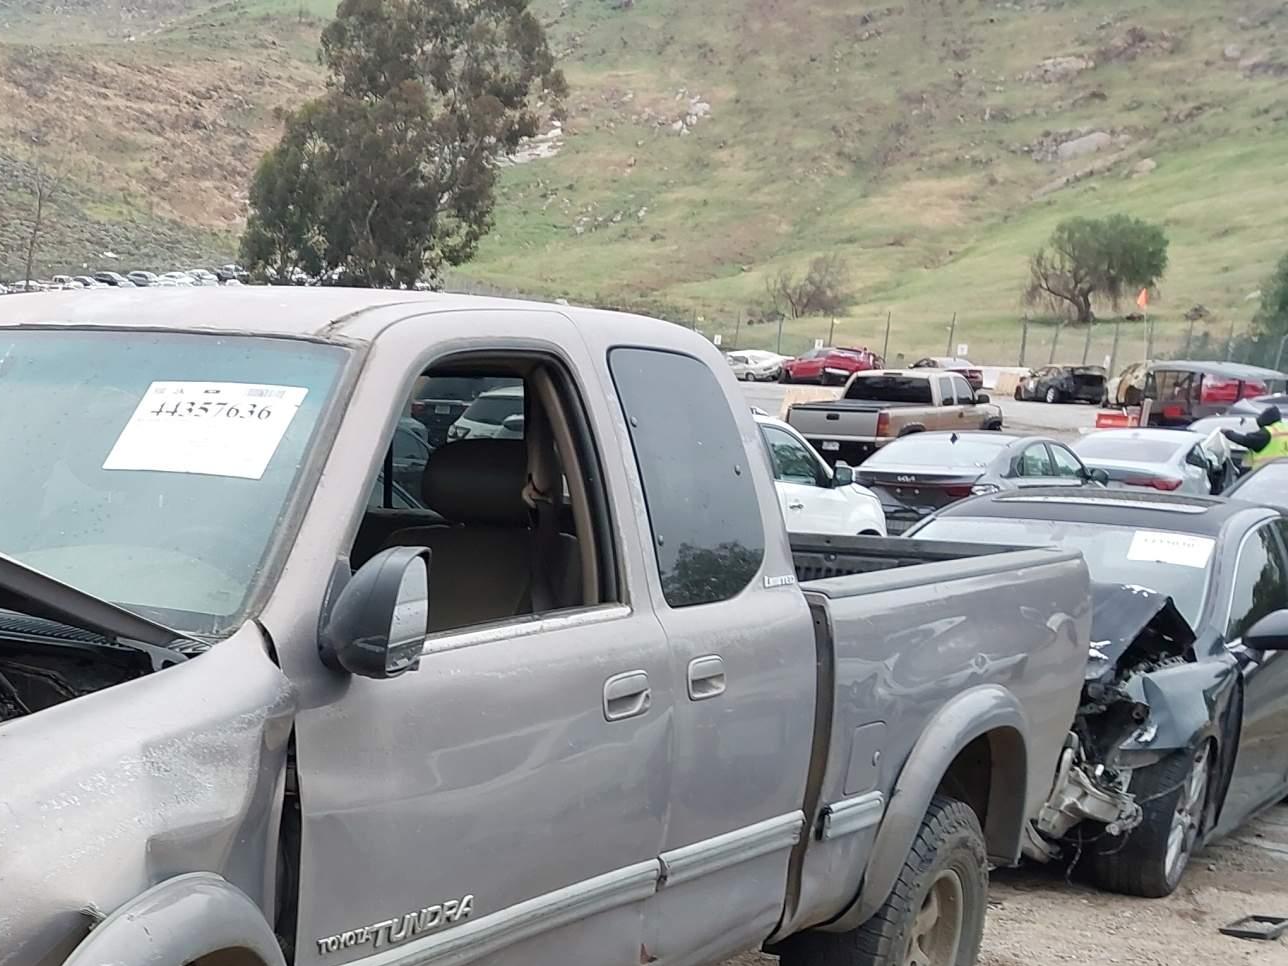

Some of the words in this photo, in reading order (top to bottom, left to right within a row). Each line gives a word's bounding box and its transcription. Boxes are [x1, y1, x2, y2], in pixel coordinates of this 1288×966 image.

[150, 400, 272, 420] 44357636
[317, 926, 372, 955] TOYOTA
[371, 894, 474, 949] TUNDRA
